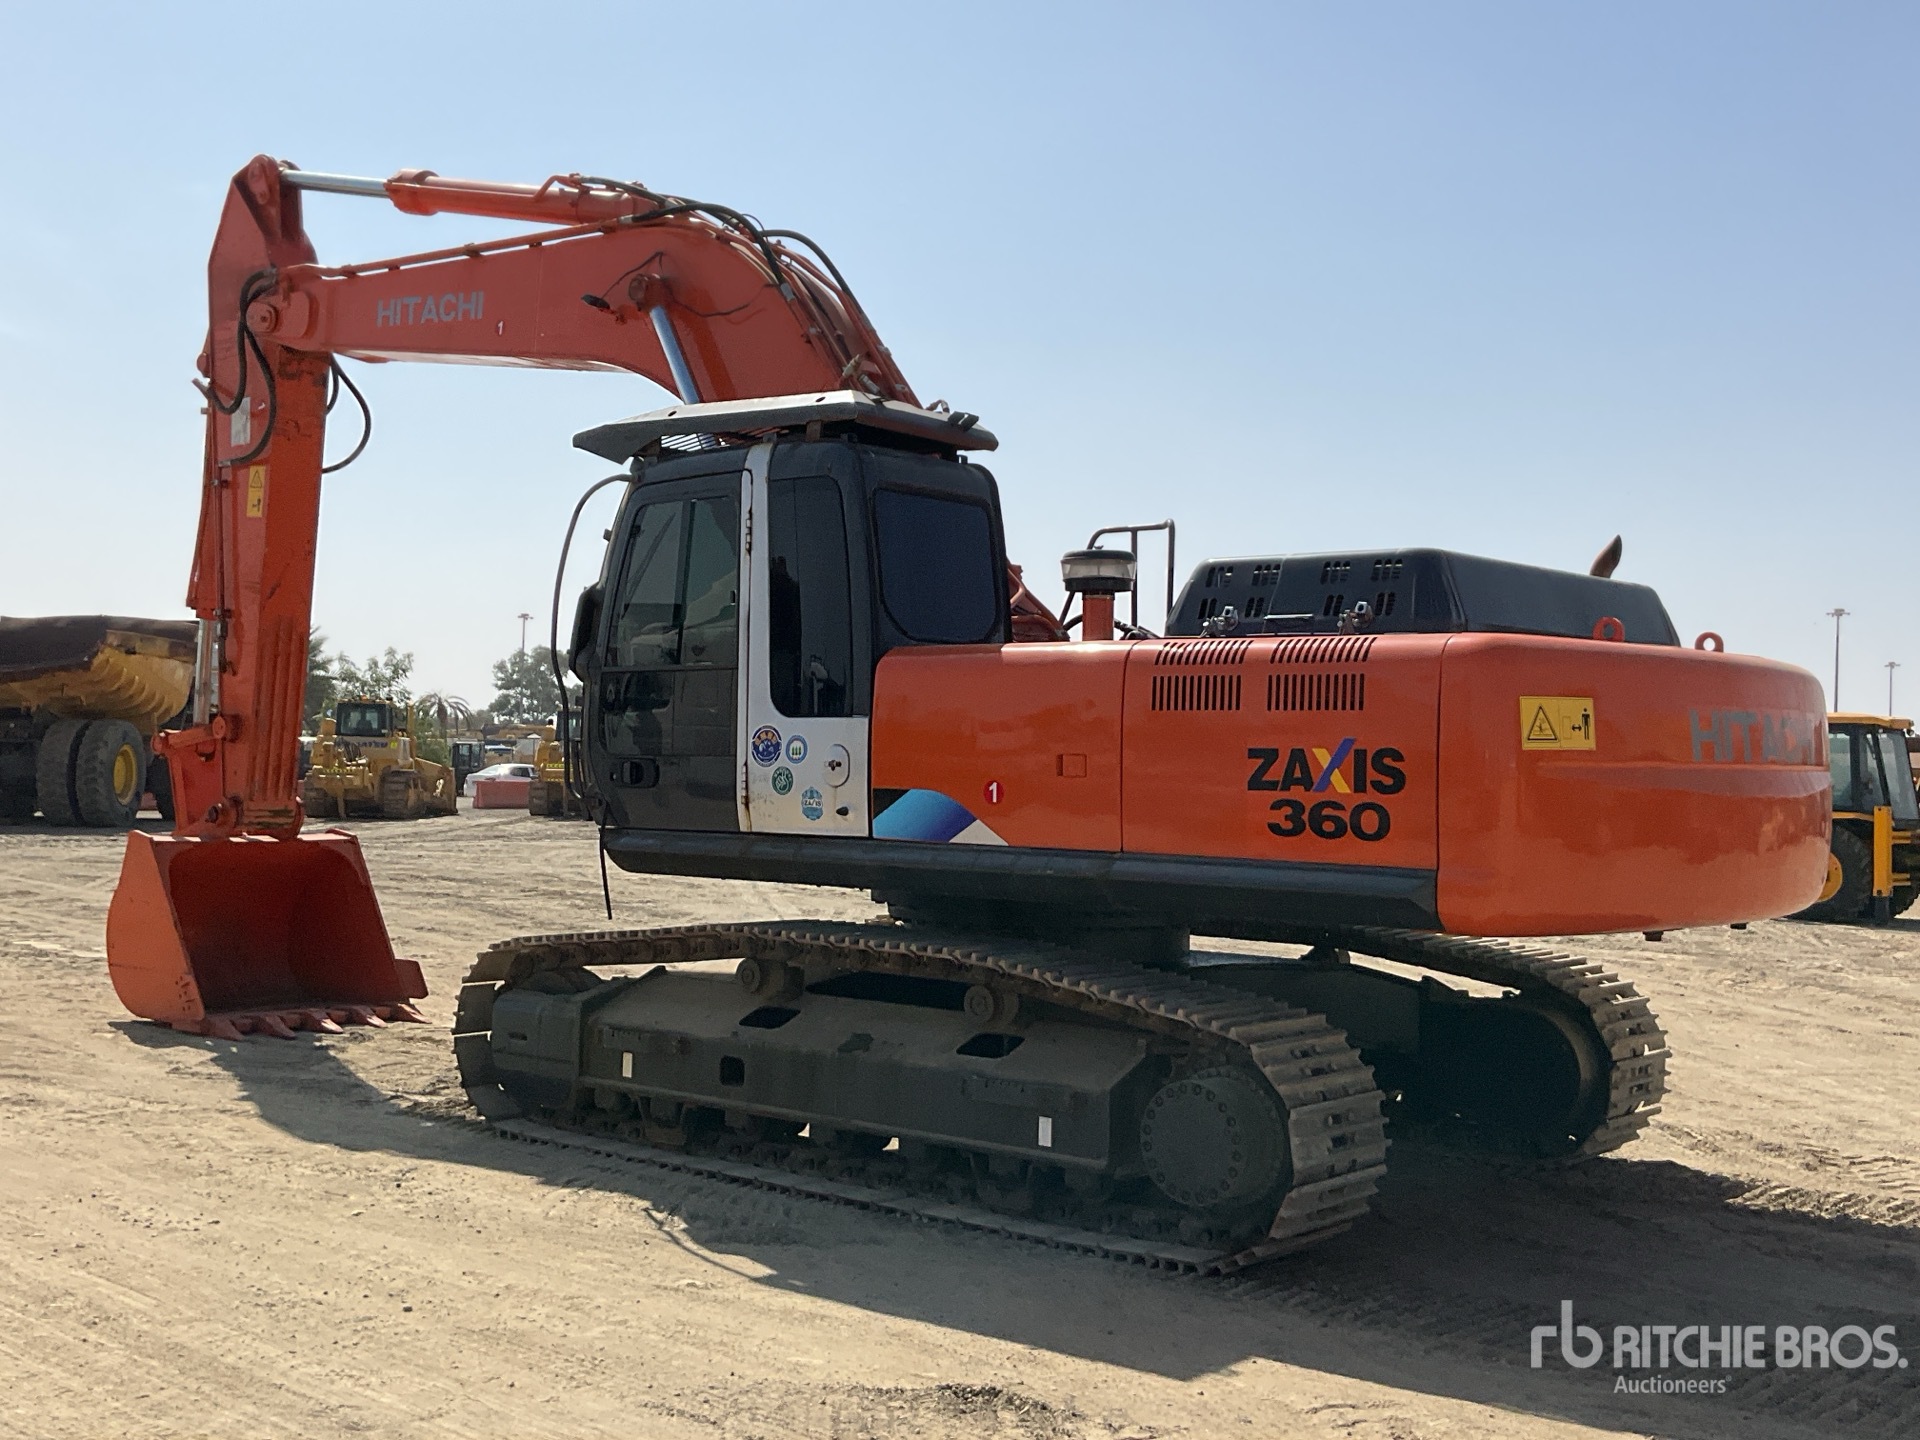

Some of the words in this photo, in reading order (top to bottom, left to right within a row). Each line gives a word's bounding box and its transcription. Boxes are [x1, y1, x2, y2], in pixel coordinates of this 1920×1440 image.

[376, 290, 485, 327] HITACHI
[1247, 737, 1407, 795] ZAXIS
[988, 781, 998, 803] 1
[1267, 798, 1391, 842] 360
